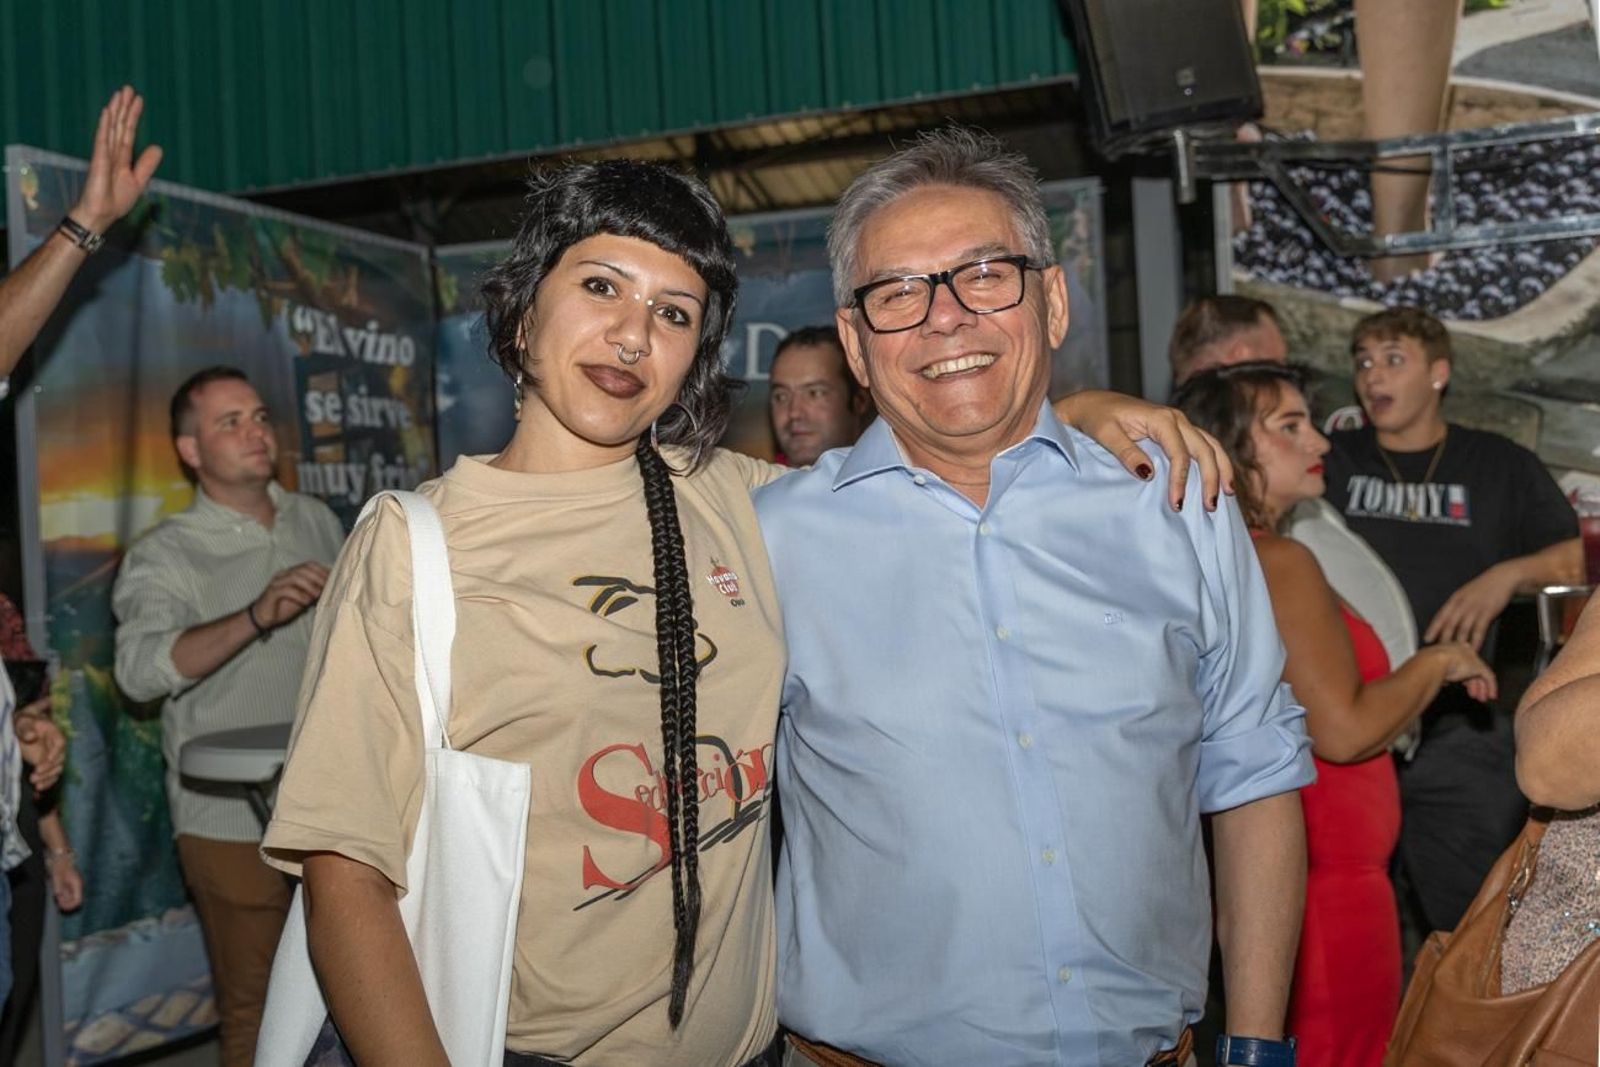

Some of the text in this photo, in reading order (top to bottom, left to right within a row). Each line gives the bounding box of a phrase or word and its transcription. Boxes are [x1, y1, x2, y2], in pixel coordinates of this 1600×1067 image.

[343, 320, 415, 367] vino
[305, 384, 413, 428] se sirve
[296, 461, 367, 505] muy
[1346, 475, 1445, 516] TOMMY
[706, 573, 738, 585] Havana
[719, 582, 738, 594] Club
